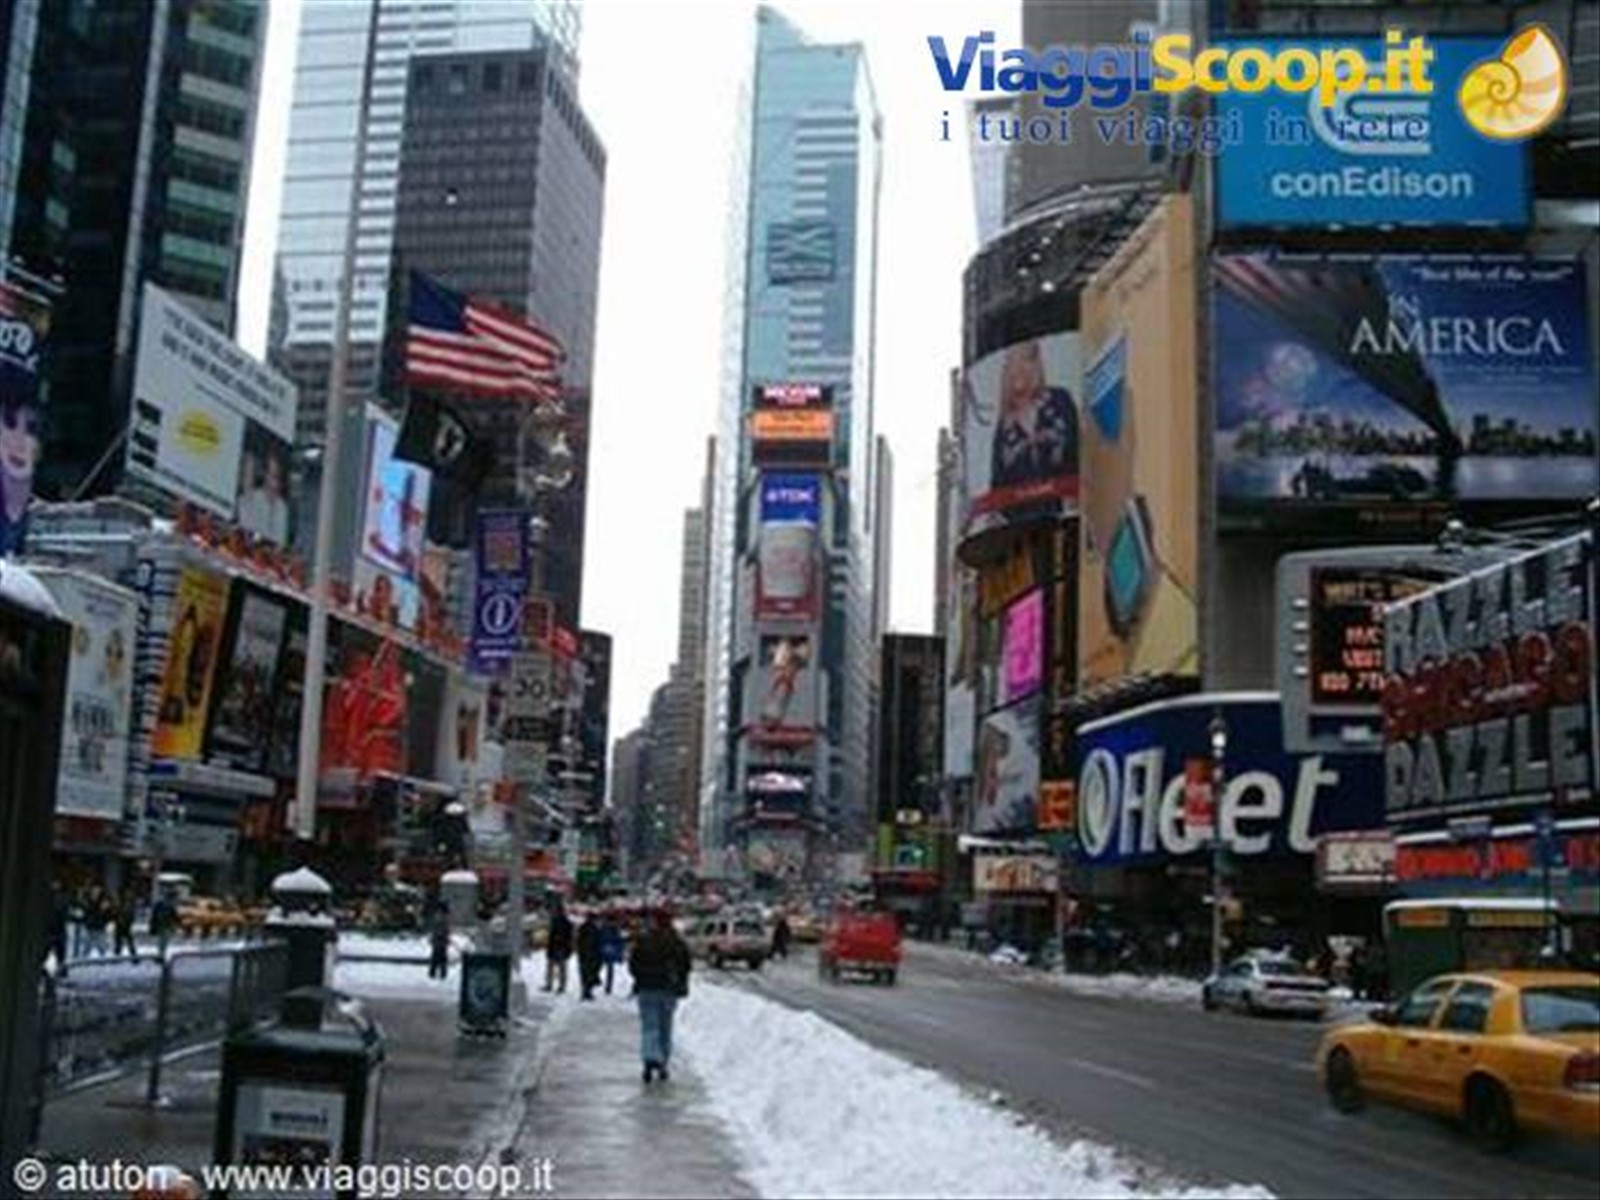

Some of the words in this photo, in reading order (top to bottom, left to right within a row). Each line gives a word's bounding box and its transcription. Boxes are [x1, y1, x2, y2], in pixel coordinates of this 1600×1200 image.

[1270, 165, 1474, 200] conEdison
[1350, 317, 1564, 356] AMERICA
[1385, 546, 1592, 676] RAZZLE
[1385, 706, 1590, 808] DAZZLE
